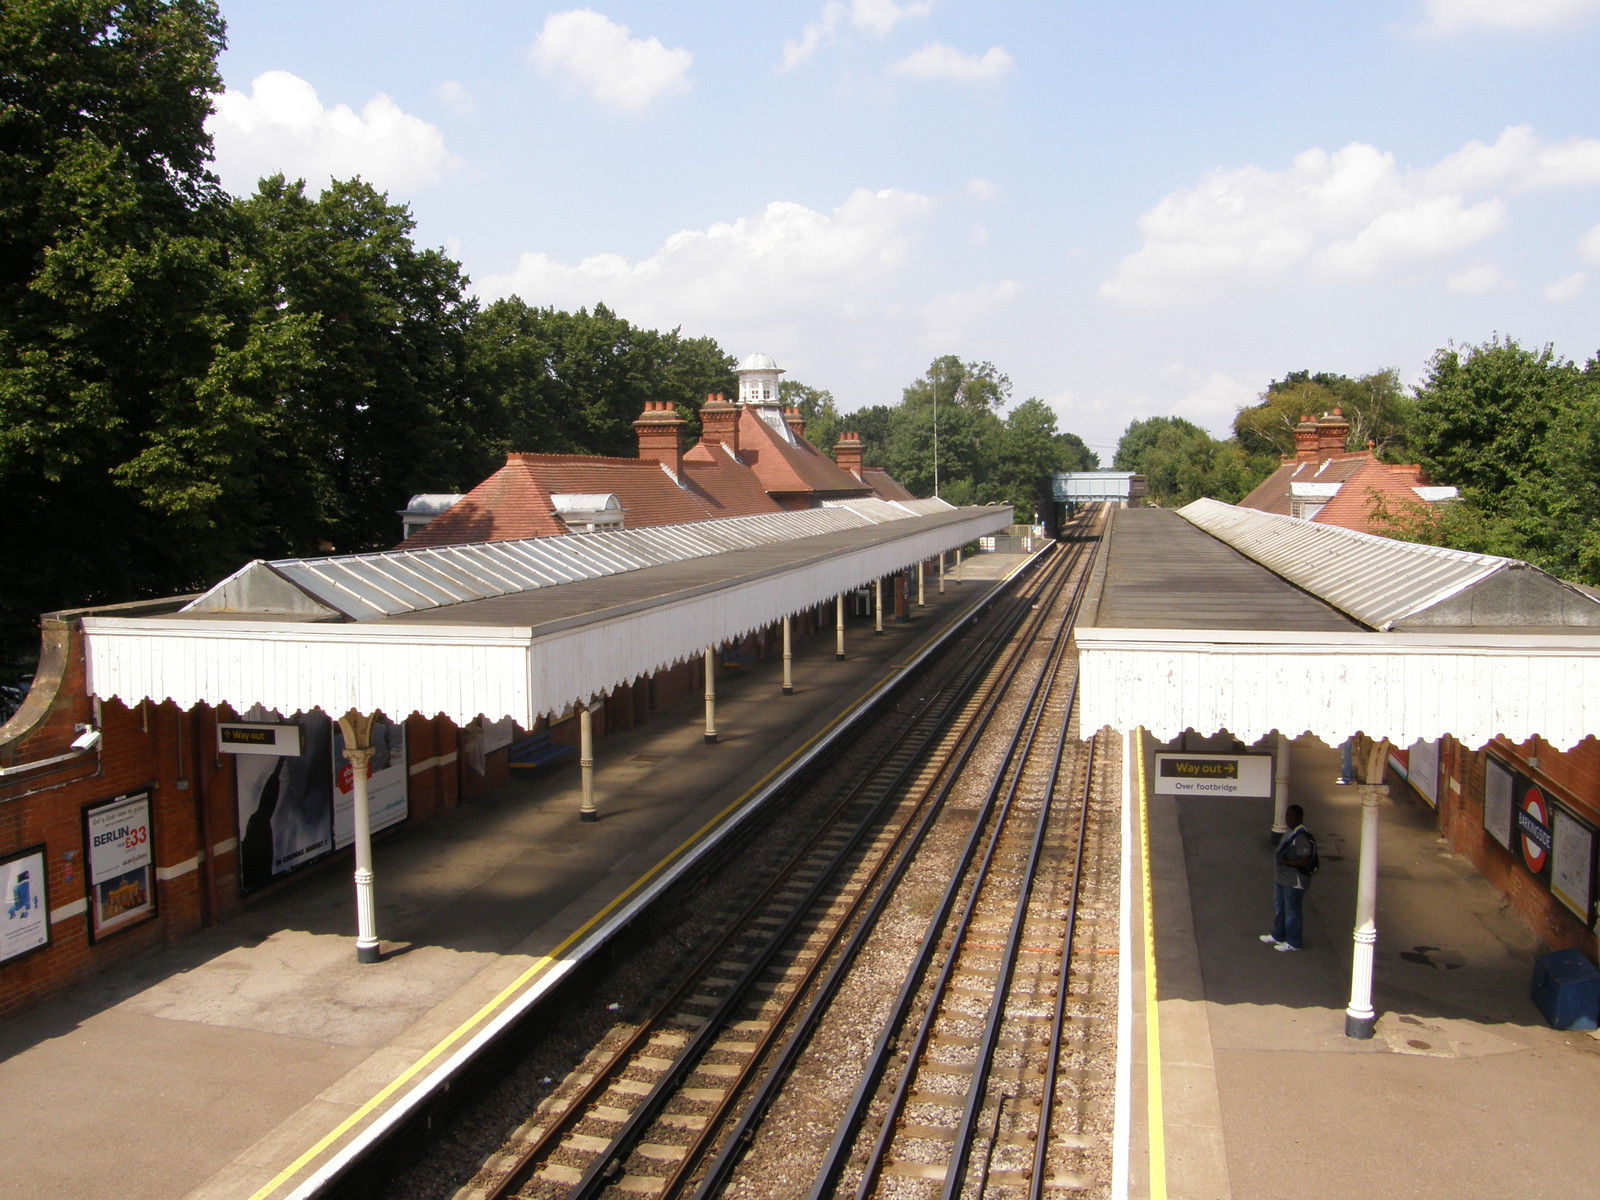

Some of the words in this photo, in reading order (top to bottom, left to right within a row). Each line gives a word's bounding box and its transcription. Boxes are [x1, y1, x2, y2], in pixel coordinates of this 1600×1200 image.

[232, 731, 249, 741] Way
[250, 732, 265, 741] out
[1176, 762, 1200, 774] Way
[1202, 765, 1222, 773] out
[1175, 782, 1194, 790] Over
[1196, 783, 1238, 792] footbridge
[1518, 811, 1551, 848] BARKINGSIDE
[93, 825, 129, 848] BERLIN
[125, 825, 147, 849] £33
